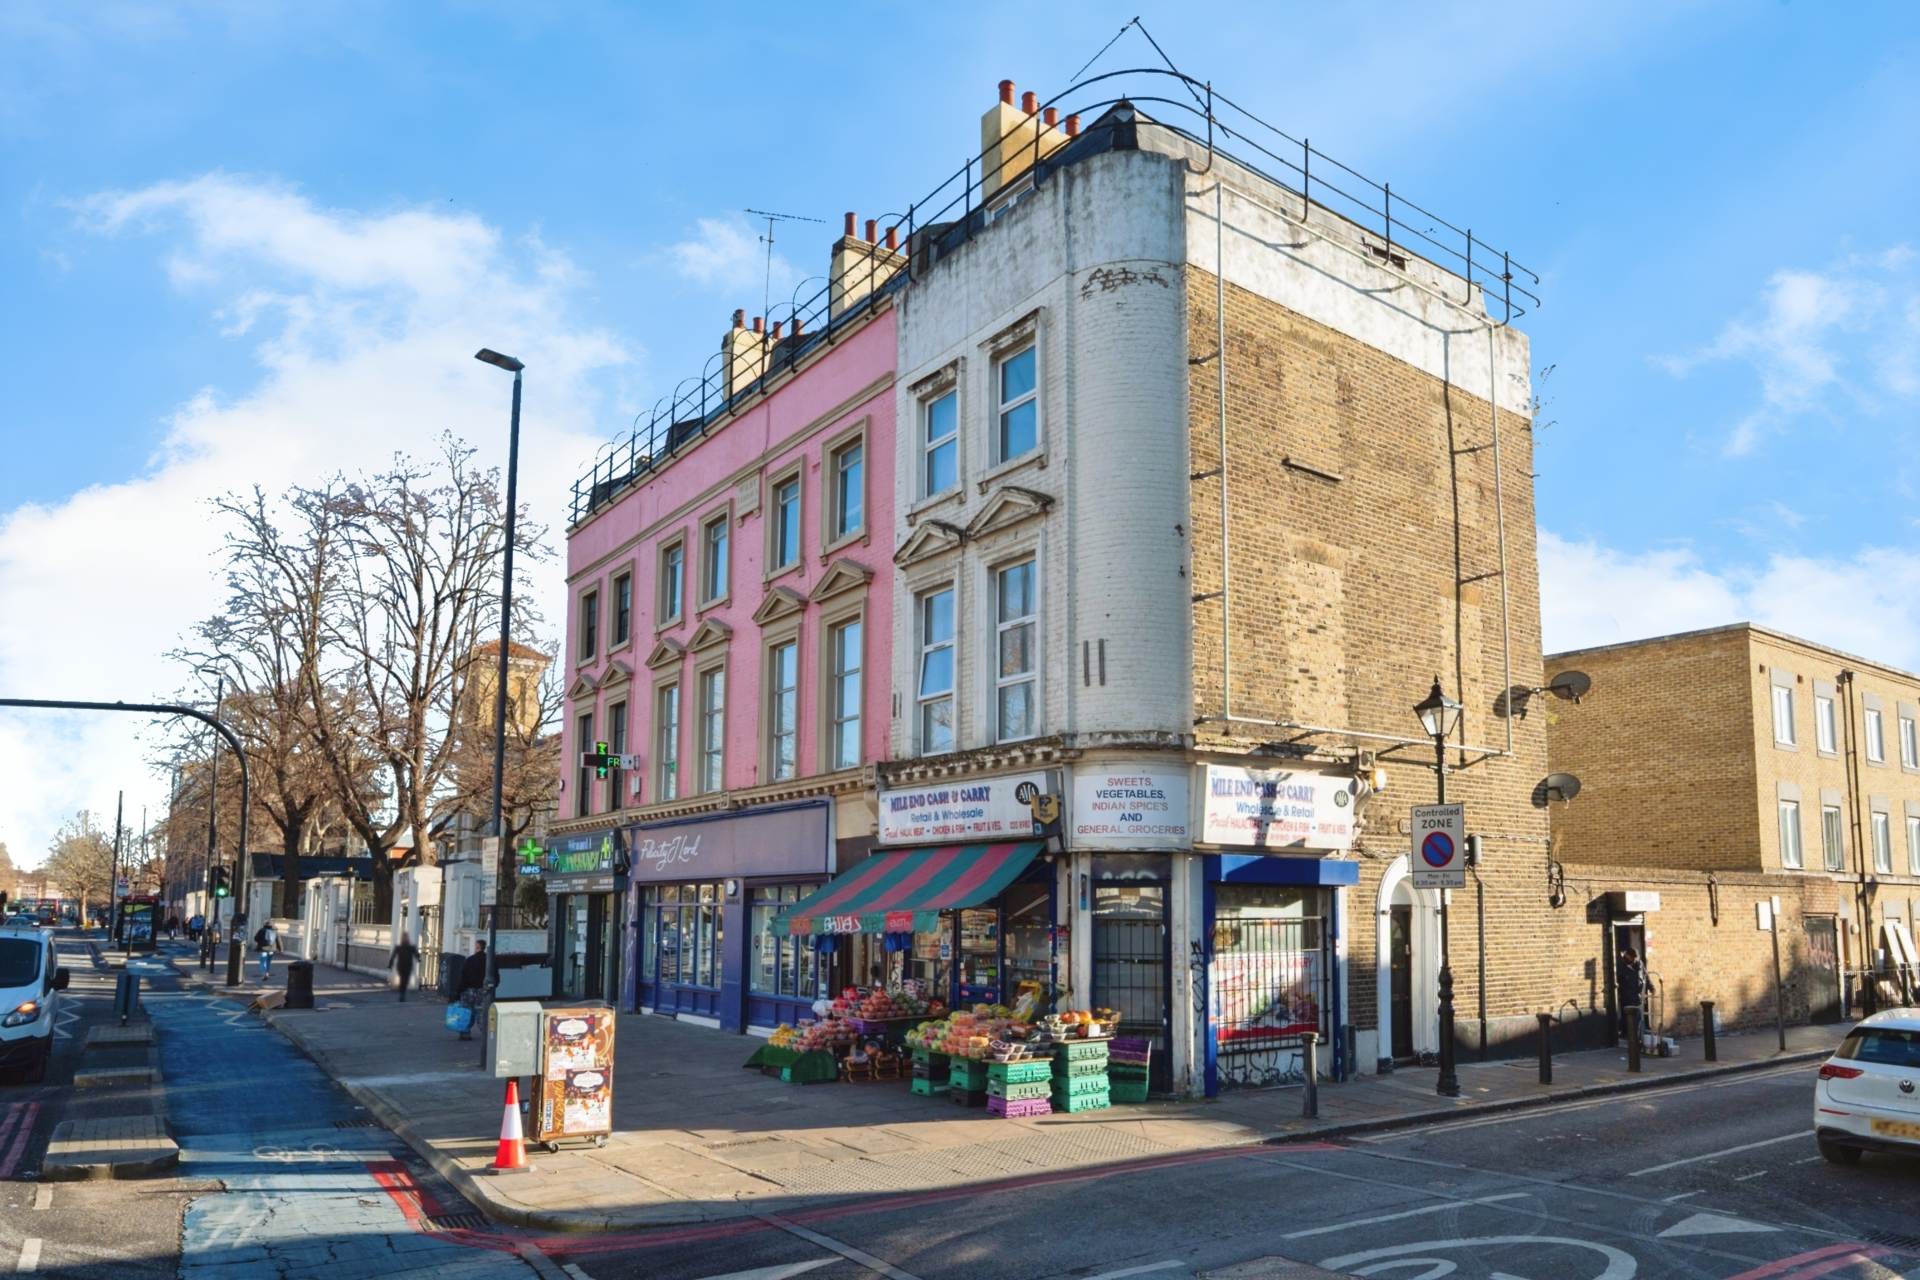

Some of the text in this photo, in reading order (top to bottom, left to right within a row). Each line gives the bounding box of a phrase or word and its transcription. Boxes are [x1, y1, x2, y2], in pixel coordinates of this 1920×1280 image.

[1107, 777, 1154, 788] SWEETS,
[1096, 789, 1167, 800] VEGETABLES,
[1211, 778, 1233, 798] MILE
[1234, 779, 1253, 797] END
[1254, 781, 1277, 798] CASH
[1286, 783, 1315, 802] CARRY
[890, 795, 909, 812] MILE
[909, 793, 926, 809] END
[926, 792, 951, 806] CASH
[960, 786, 992, 802] CARRY
[1092, 801, 1126, 811] INDIAN
[1236, 801, 1315, 818] Wholesale & Retail
[911, 808, 984, 823] Retail & Wholesale
[1119, 813, 1143, 822] AND
[1415, 808, 1460, 818] Controlled
[1421, 818, 1453, 829] ZONE
[1077, 825, 1185, 835] GENERAL GROCERIES
[521, 865, 541, 874] NHS
